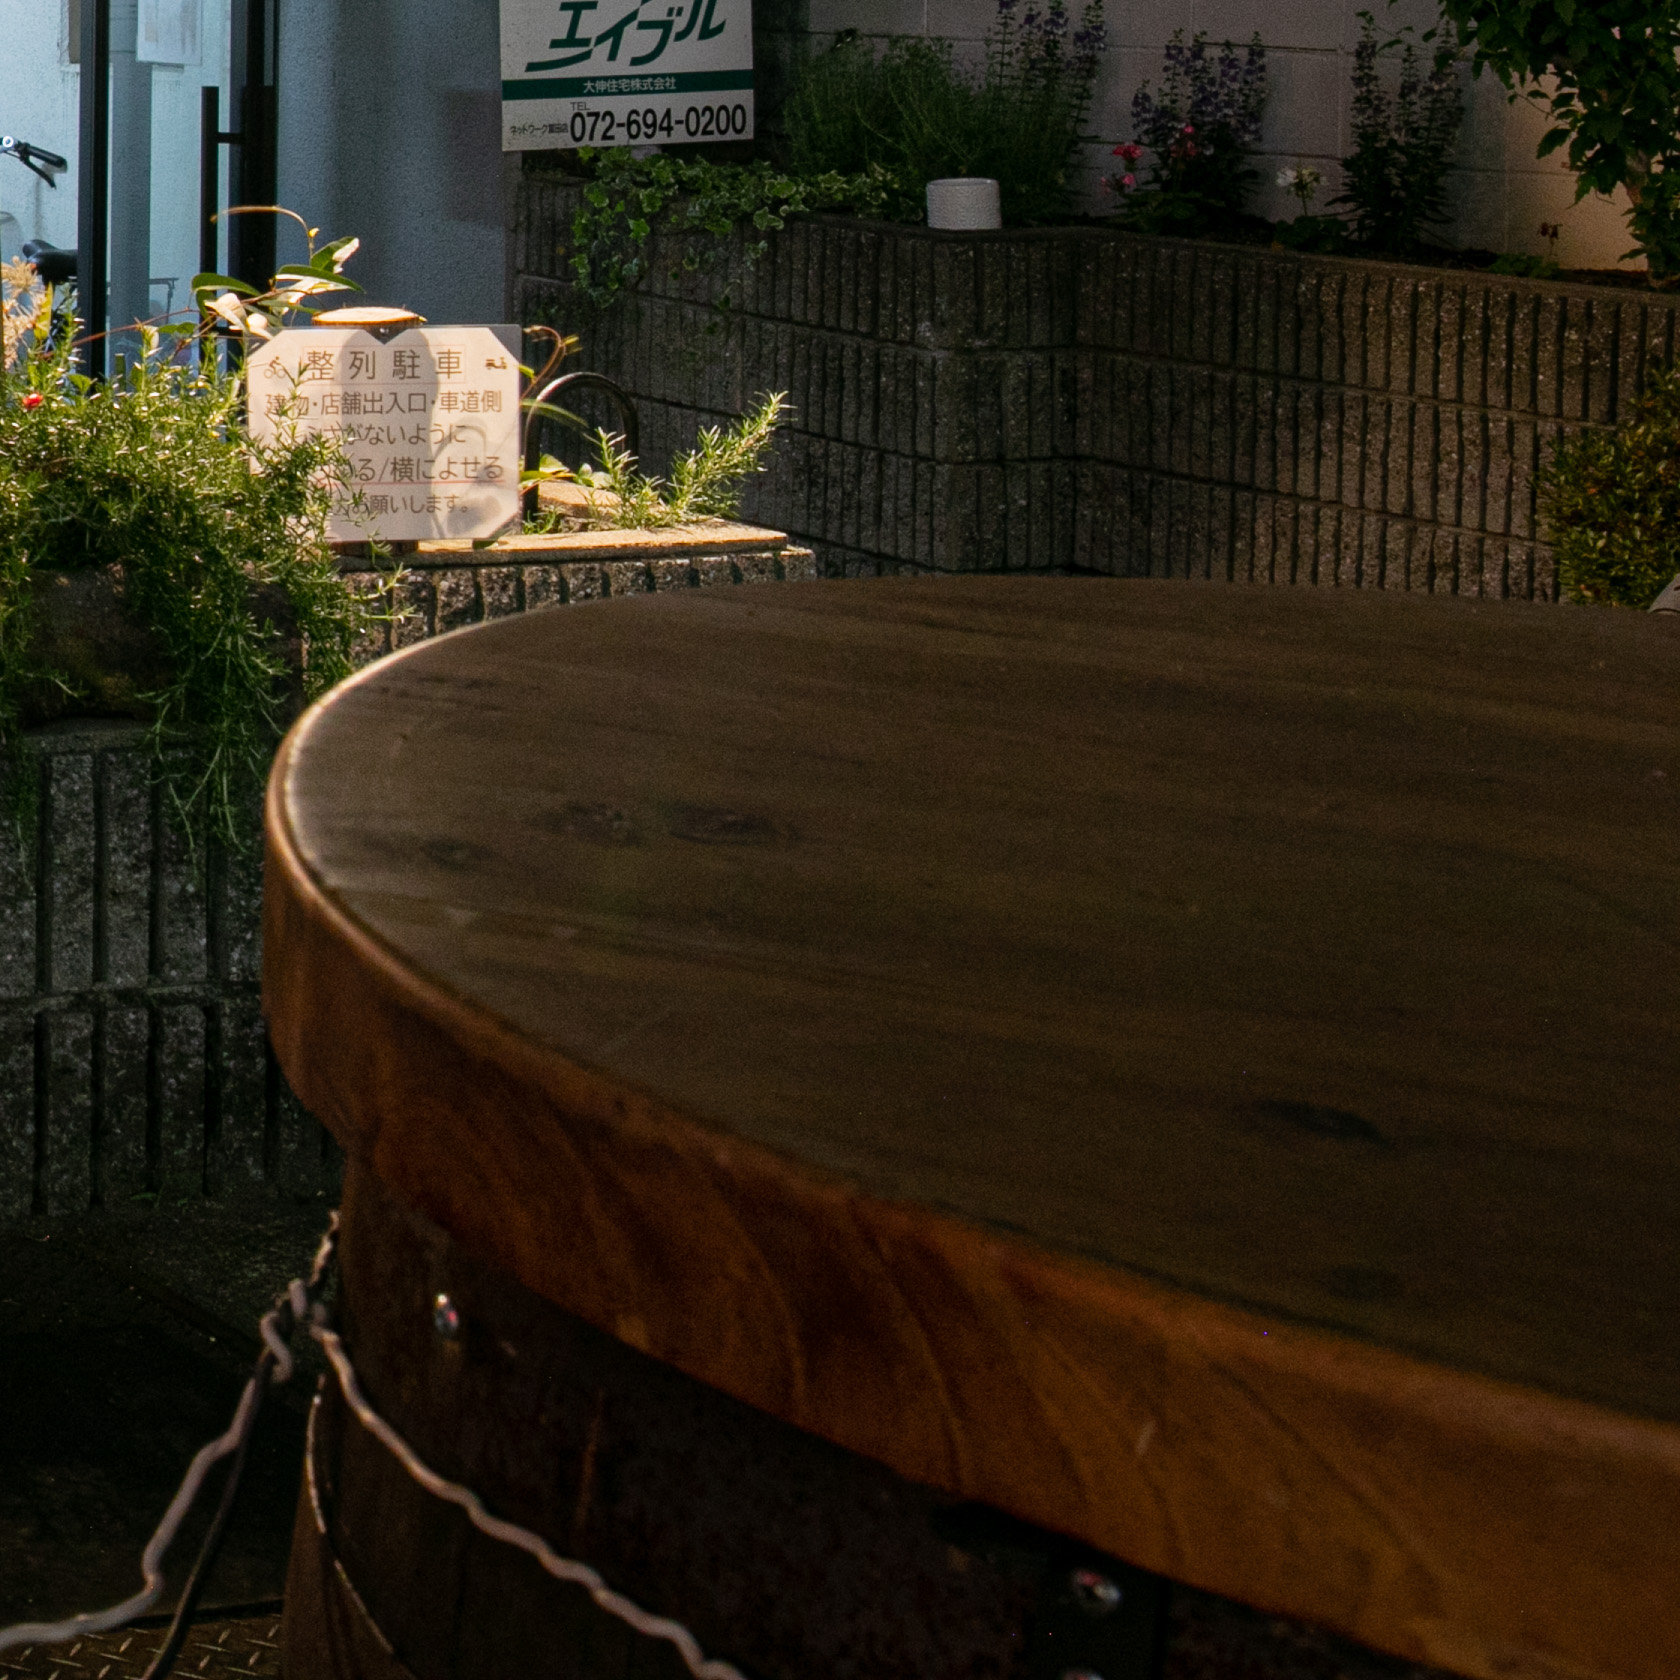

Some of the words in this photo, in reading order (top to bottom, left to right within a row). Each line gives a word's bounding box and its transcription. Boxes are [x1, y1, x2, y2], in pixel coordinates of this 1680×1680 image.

[583, 77, 677, 94] 大伸住宅株式会社
[570, 101, 591, 111] TEL
[569, 103, 747, 143] 072-694-0200
